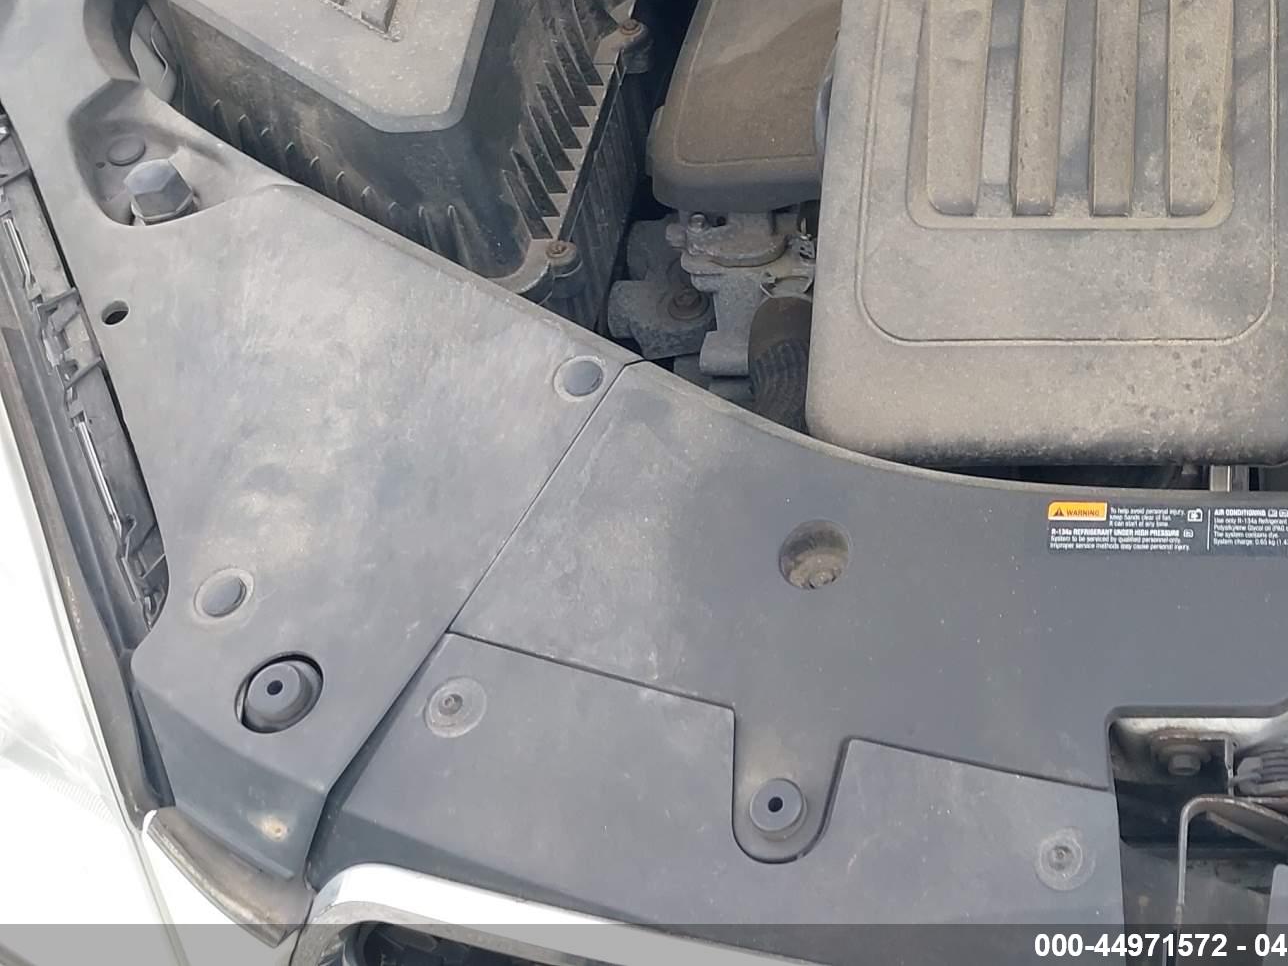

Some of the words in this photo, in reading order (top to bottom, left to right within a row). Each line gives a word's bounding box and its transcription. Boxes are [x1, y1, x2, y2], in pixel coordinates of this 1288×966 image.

[1066, 508, 1100, 516] WARNING
[1214, 508, 1225, 516] AIR
[1226, 508, 1266, 516] CONDITIONING
[1052, 528, 1072, 536] R-134a
[1072, 528, 1112, 536] REFRIGERANT
[1114, 528, 1134, 536] UNDER
[1134, 528, 1149, 536] HIGH
[1150, 529, 1180, 537] PRESSURE
